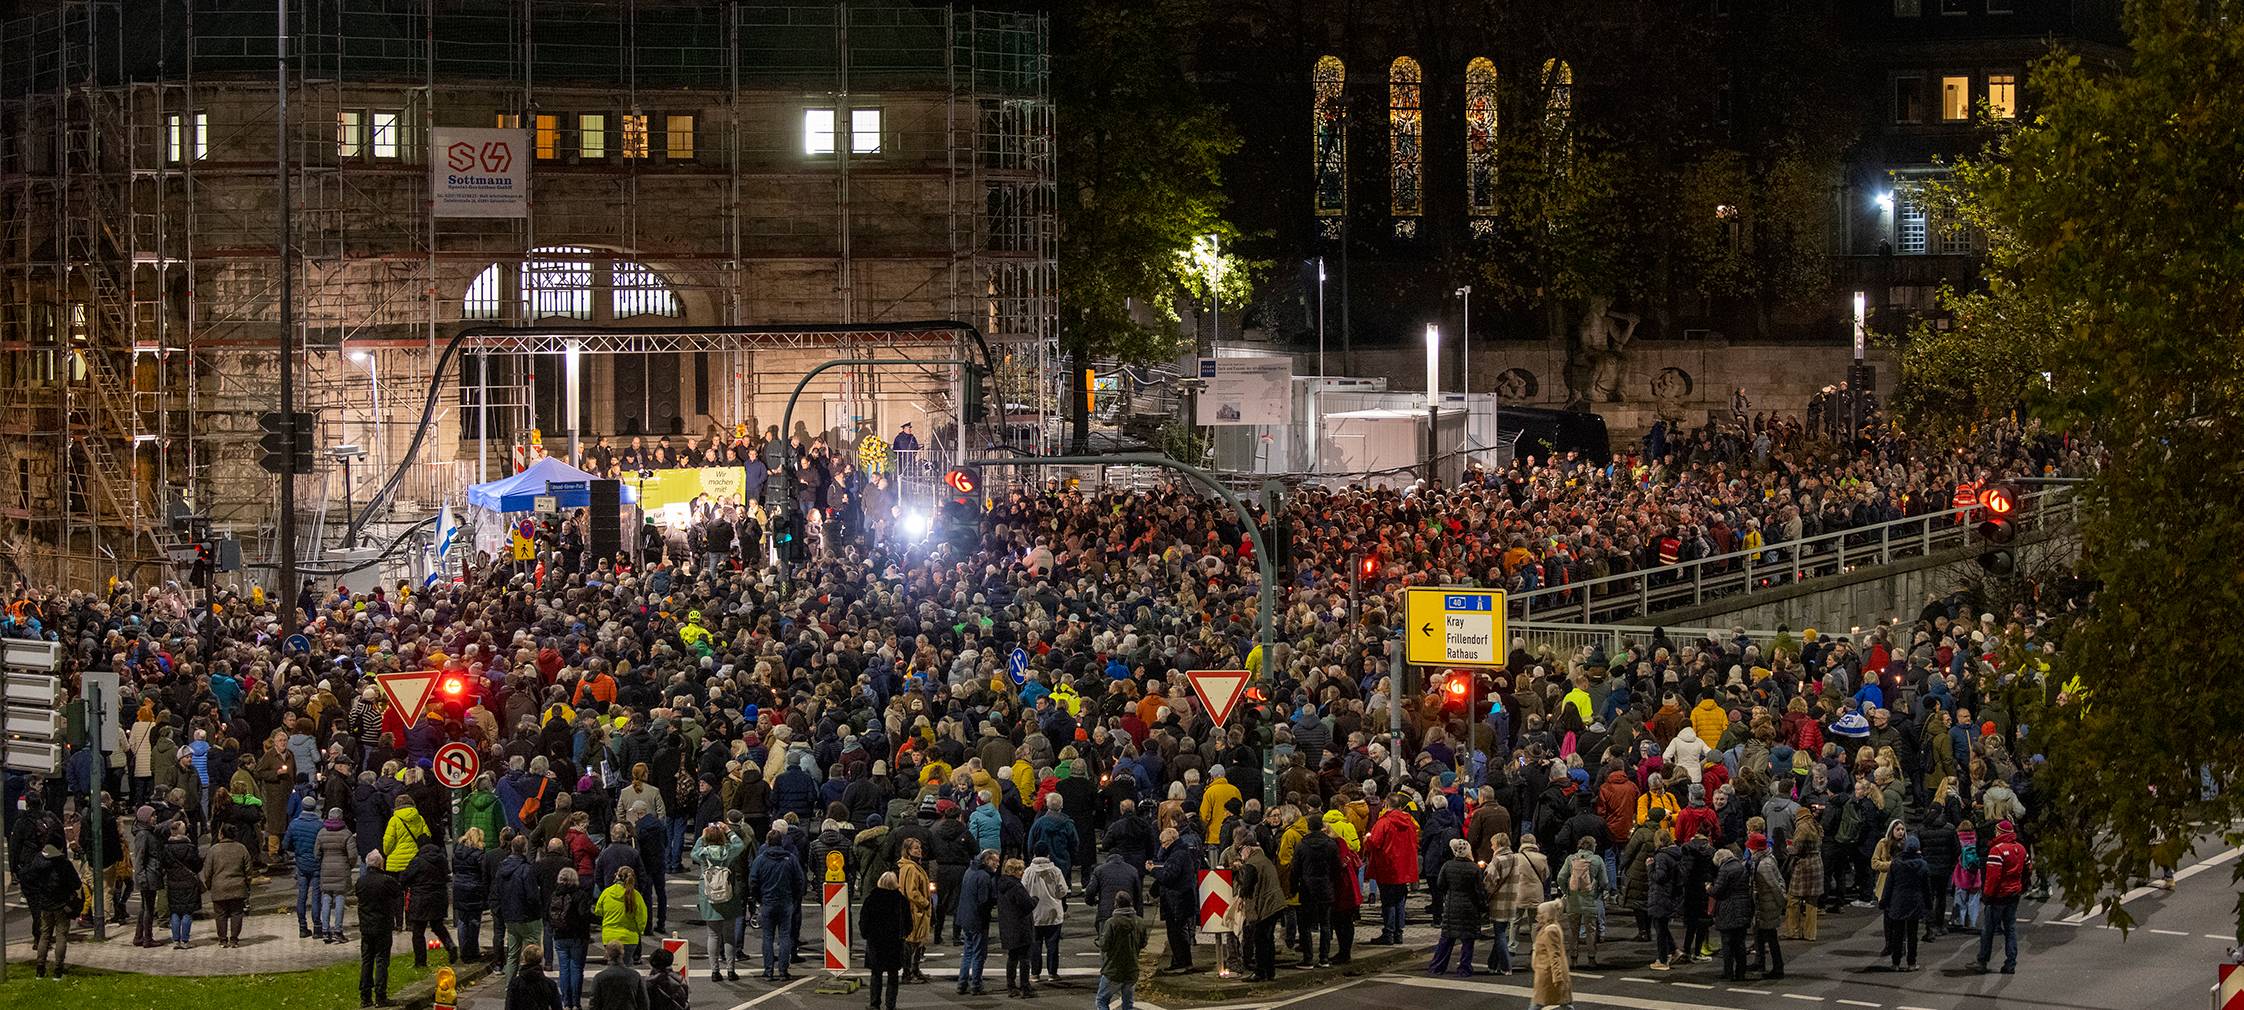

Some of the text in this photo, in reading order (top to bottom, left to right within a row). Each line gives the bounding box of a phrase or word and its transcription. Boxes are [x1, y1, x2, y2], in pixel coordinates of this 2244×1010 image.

[448, 175, 512, 184] Sottmann
[1453, 599, 1462, 607] 40
[1447, 616, 1464, 628] Kray
[1447, 633, 1487, 645] Frillendorf
[1447, 648, 1478, 659] Rathaus
